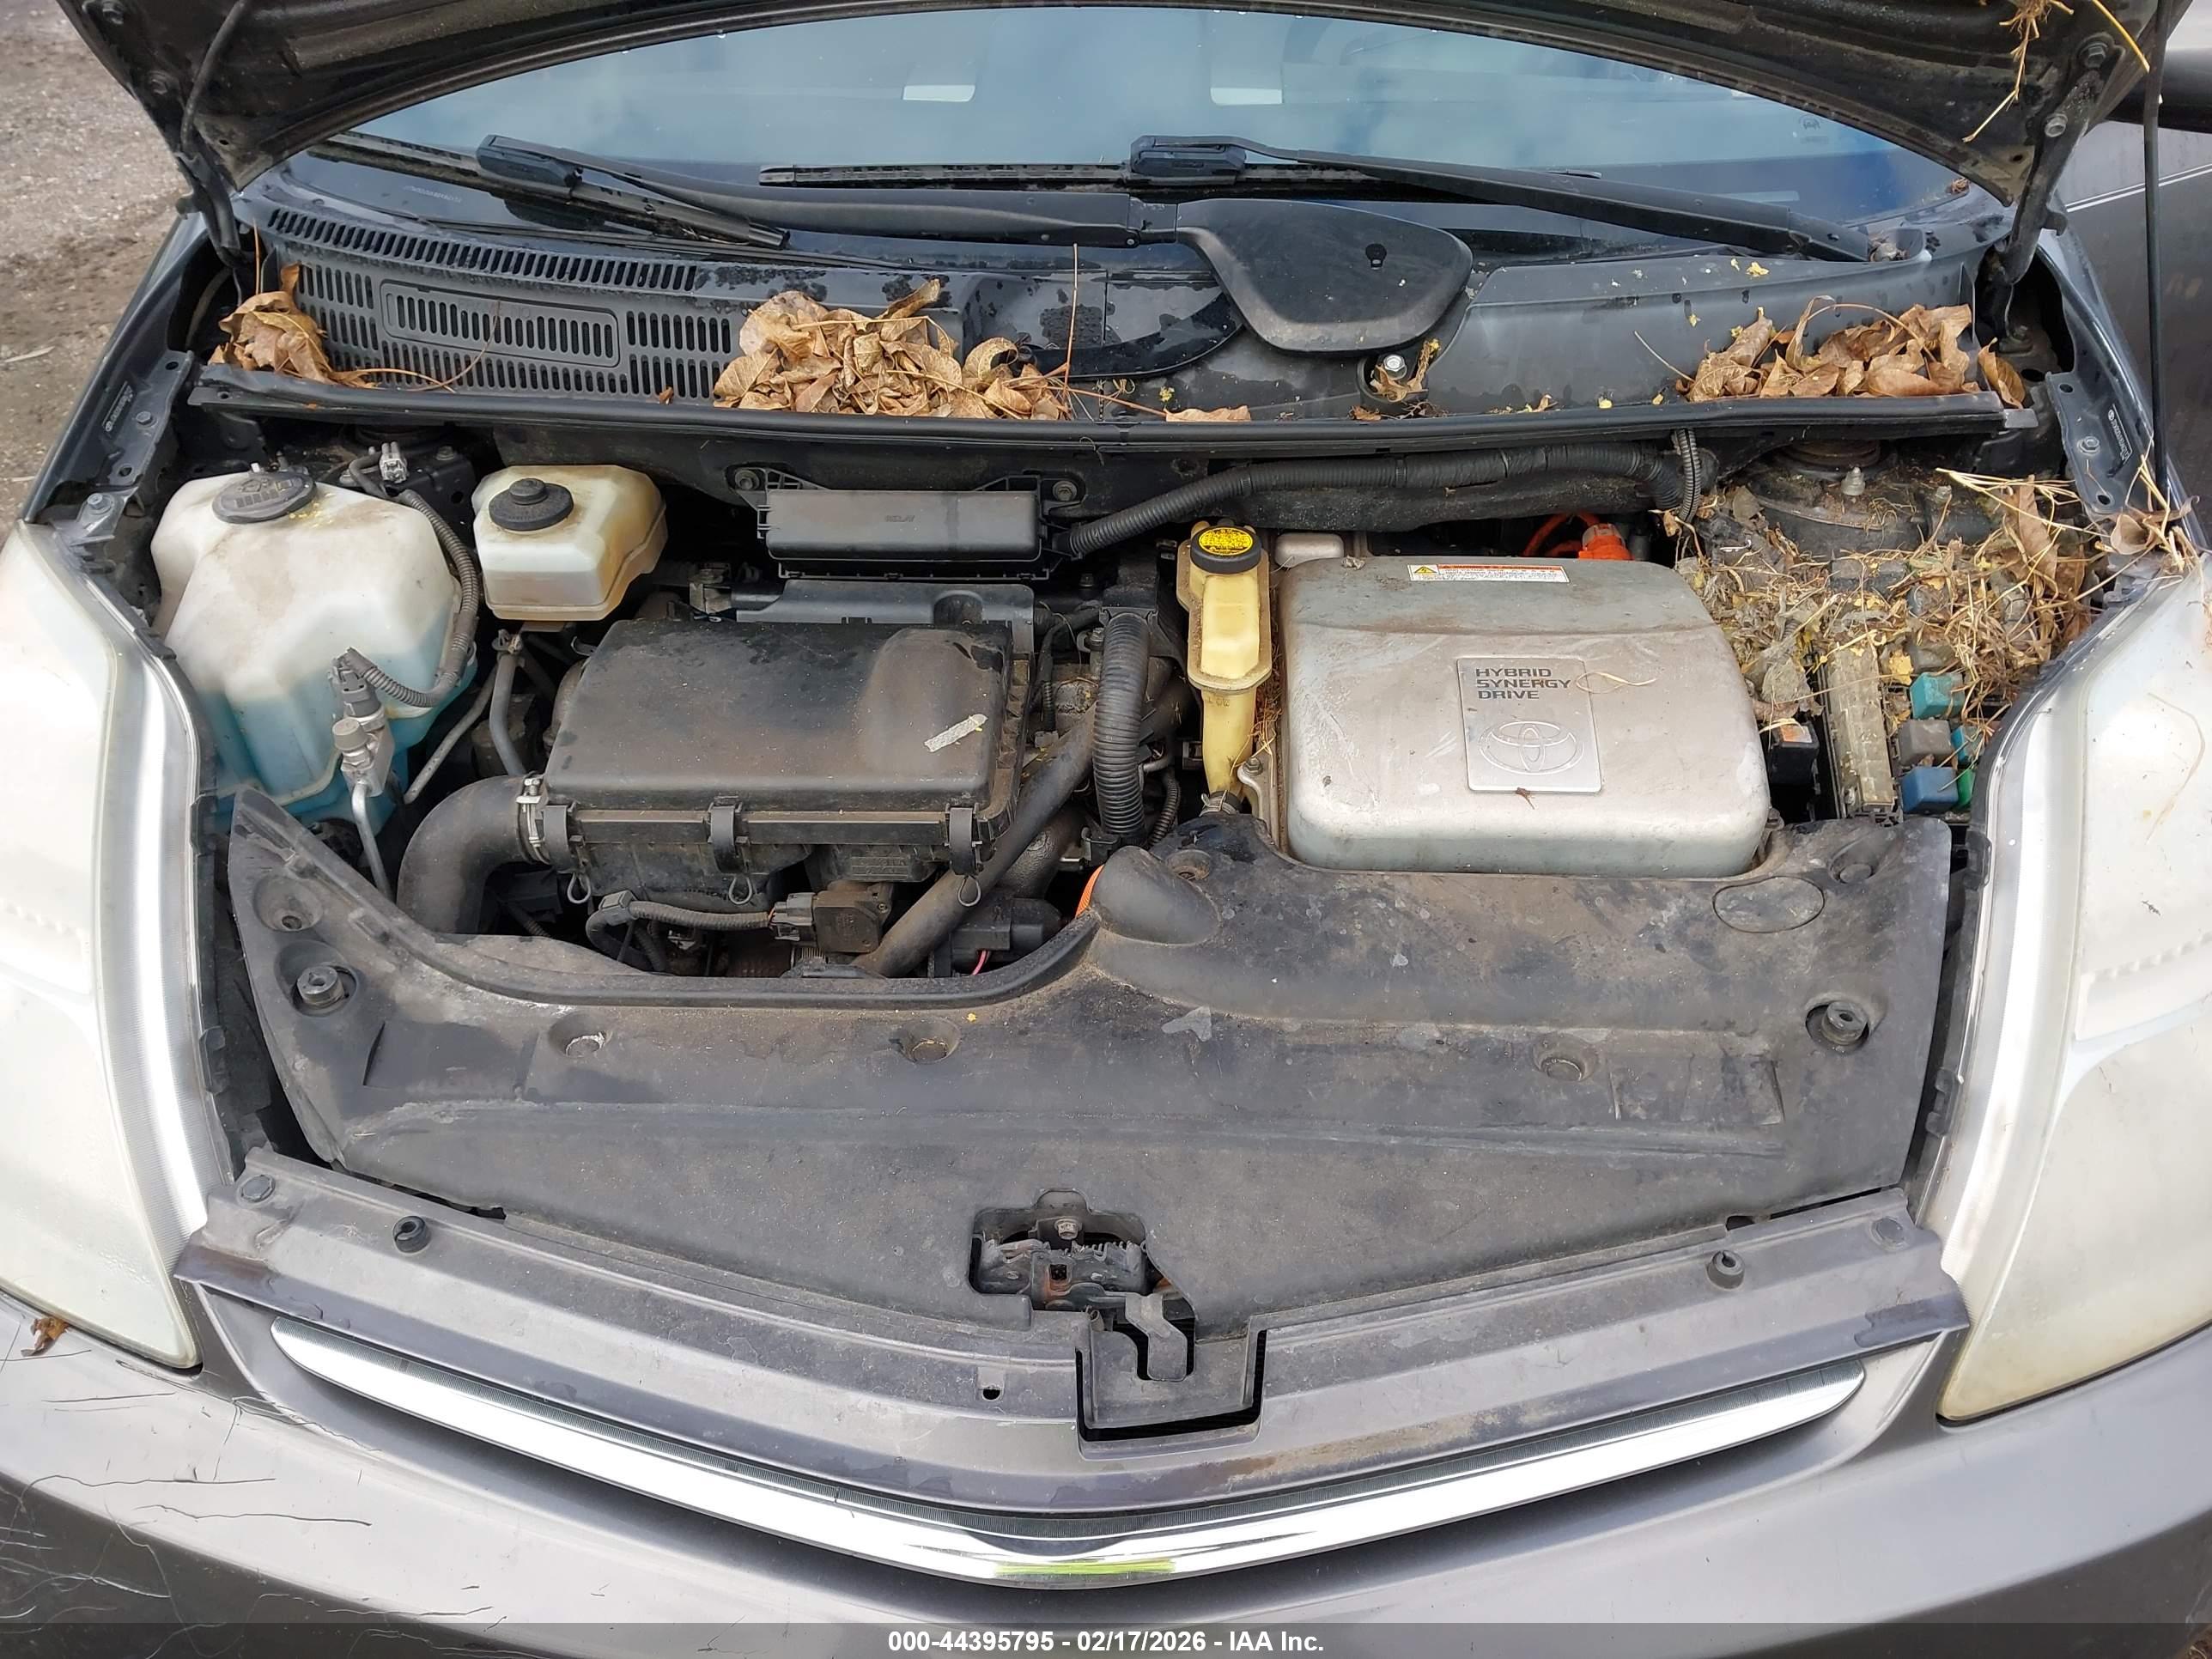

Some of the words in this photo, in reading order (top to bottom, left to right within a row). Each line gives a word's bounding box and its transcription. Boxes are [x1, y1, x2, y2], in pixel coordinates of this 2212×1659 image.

[1475, 668, 1552, 678] HYBRID
[1476, 678, 1571, 689] SYNERGY
[1478, 690, 1540, 700] DRIVE
